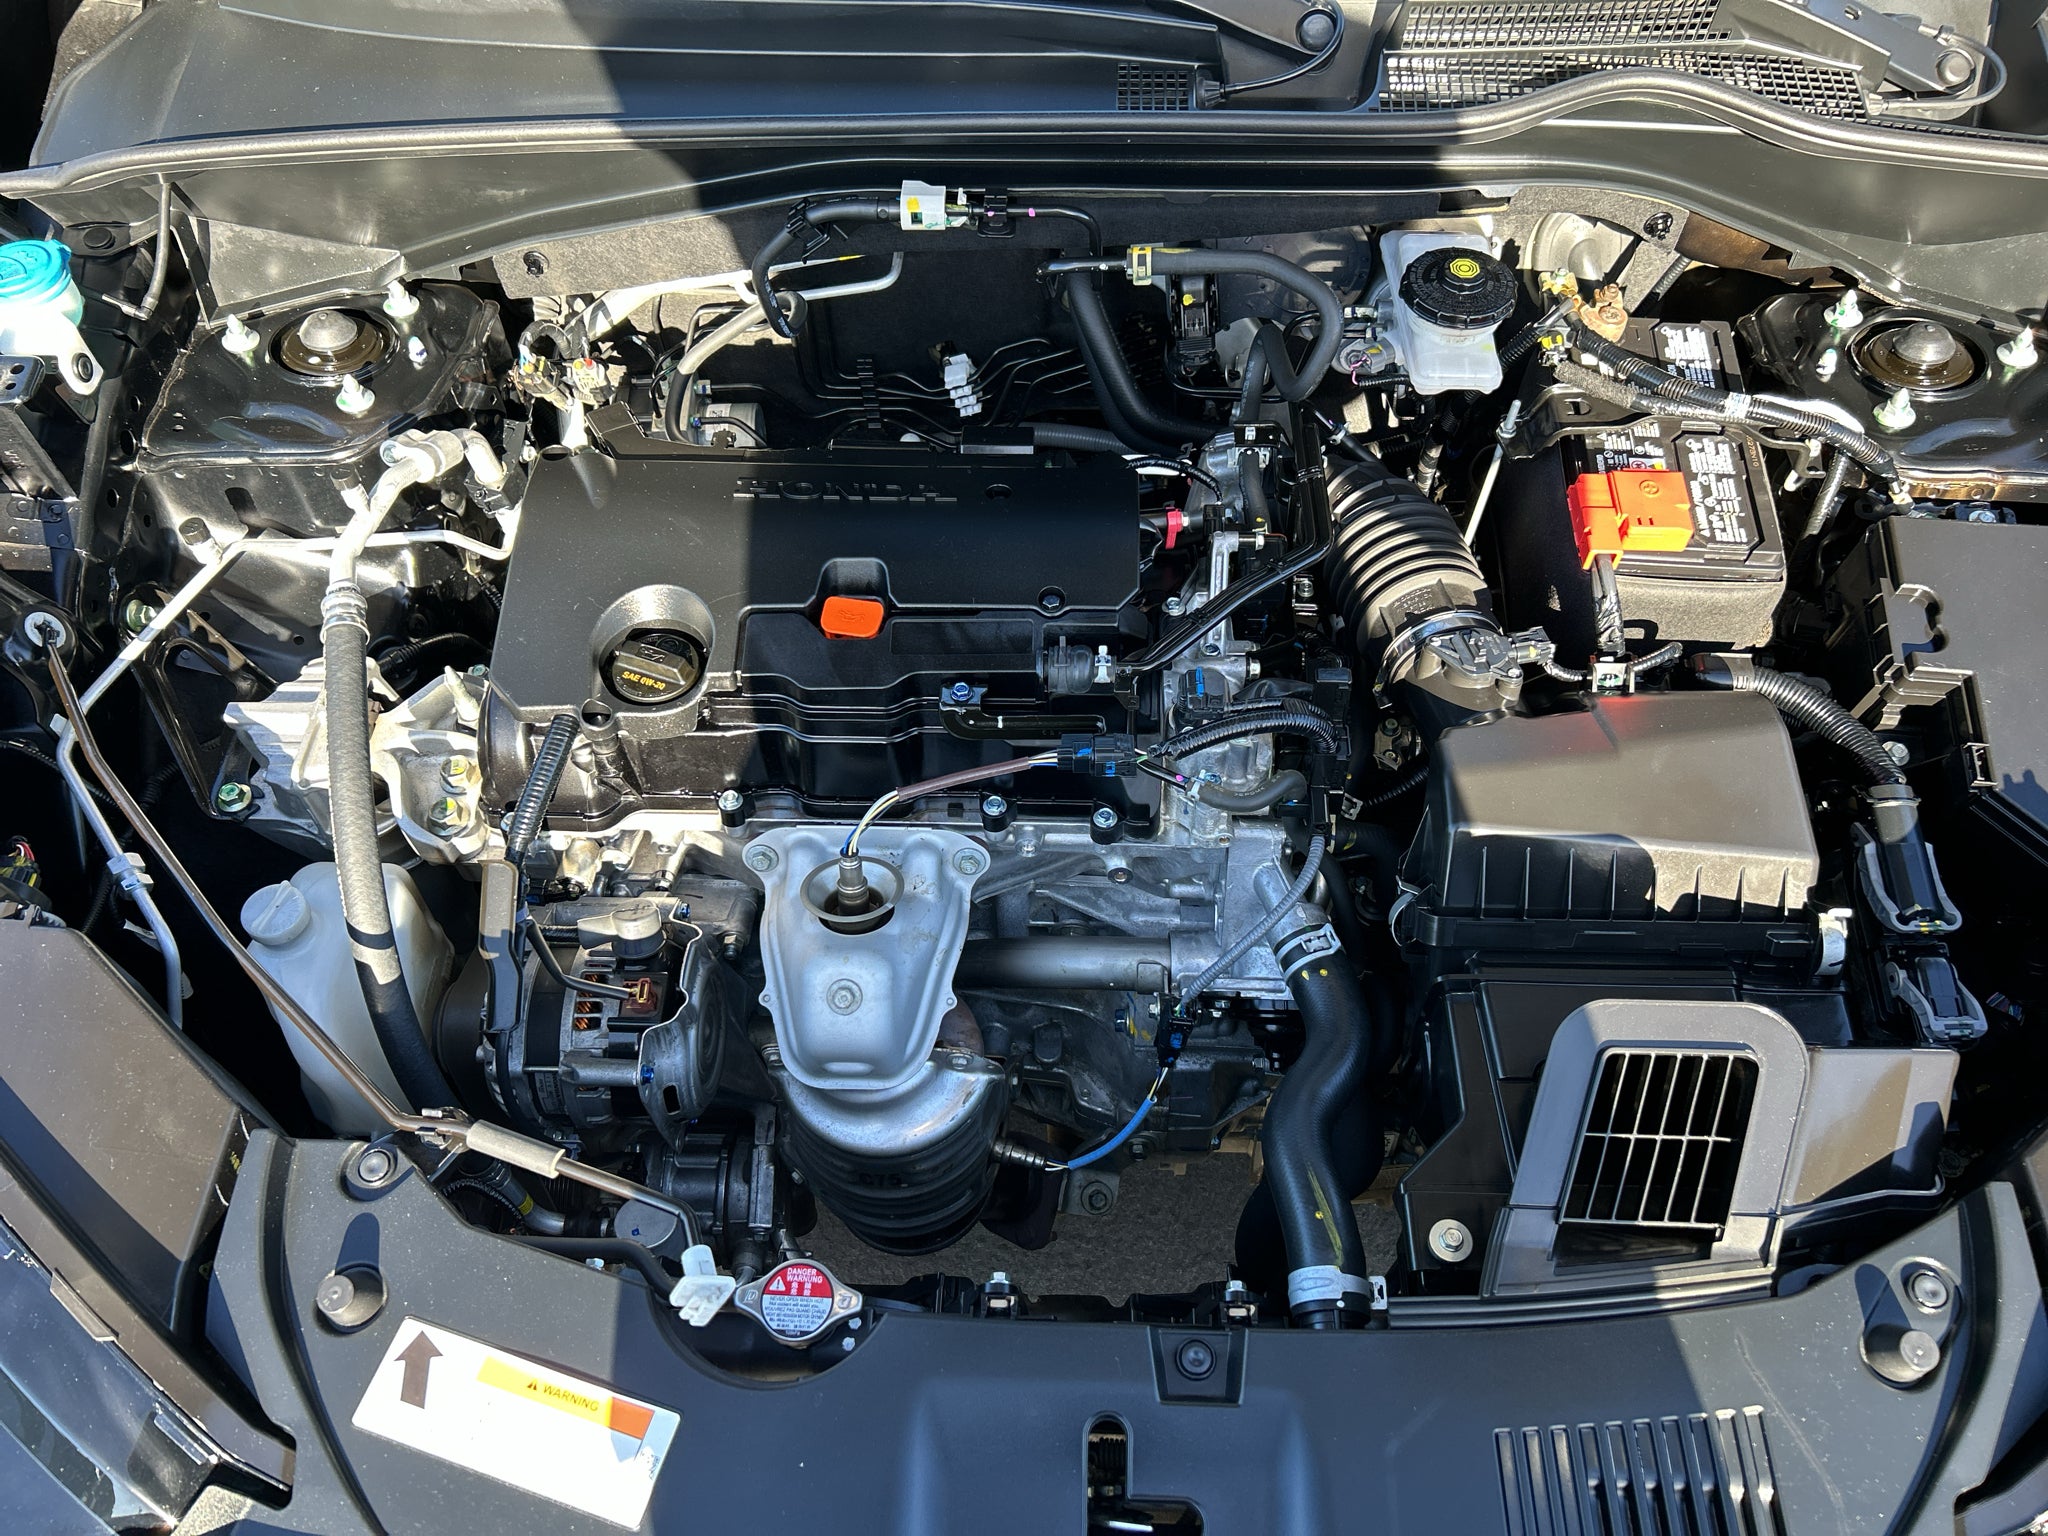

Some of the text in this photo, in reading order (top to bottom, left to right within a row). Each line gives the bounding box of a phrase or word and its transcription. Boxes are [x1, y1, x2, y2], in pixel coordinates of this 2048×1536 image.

[733, 477, 958, 502] HONDA
[622, 671, 666, 690] SAE 0W-20
[787, 1275, 823, 1283] WARNUNG
[543, 1382, 600, 1412] WARNING
